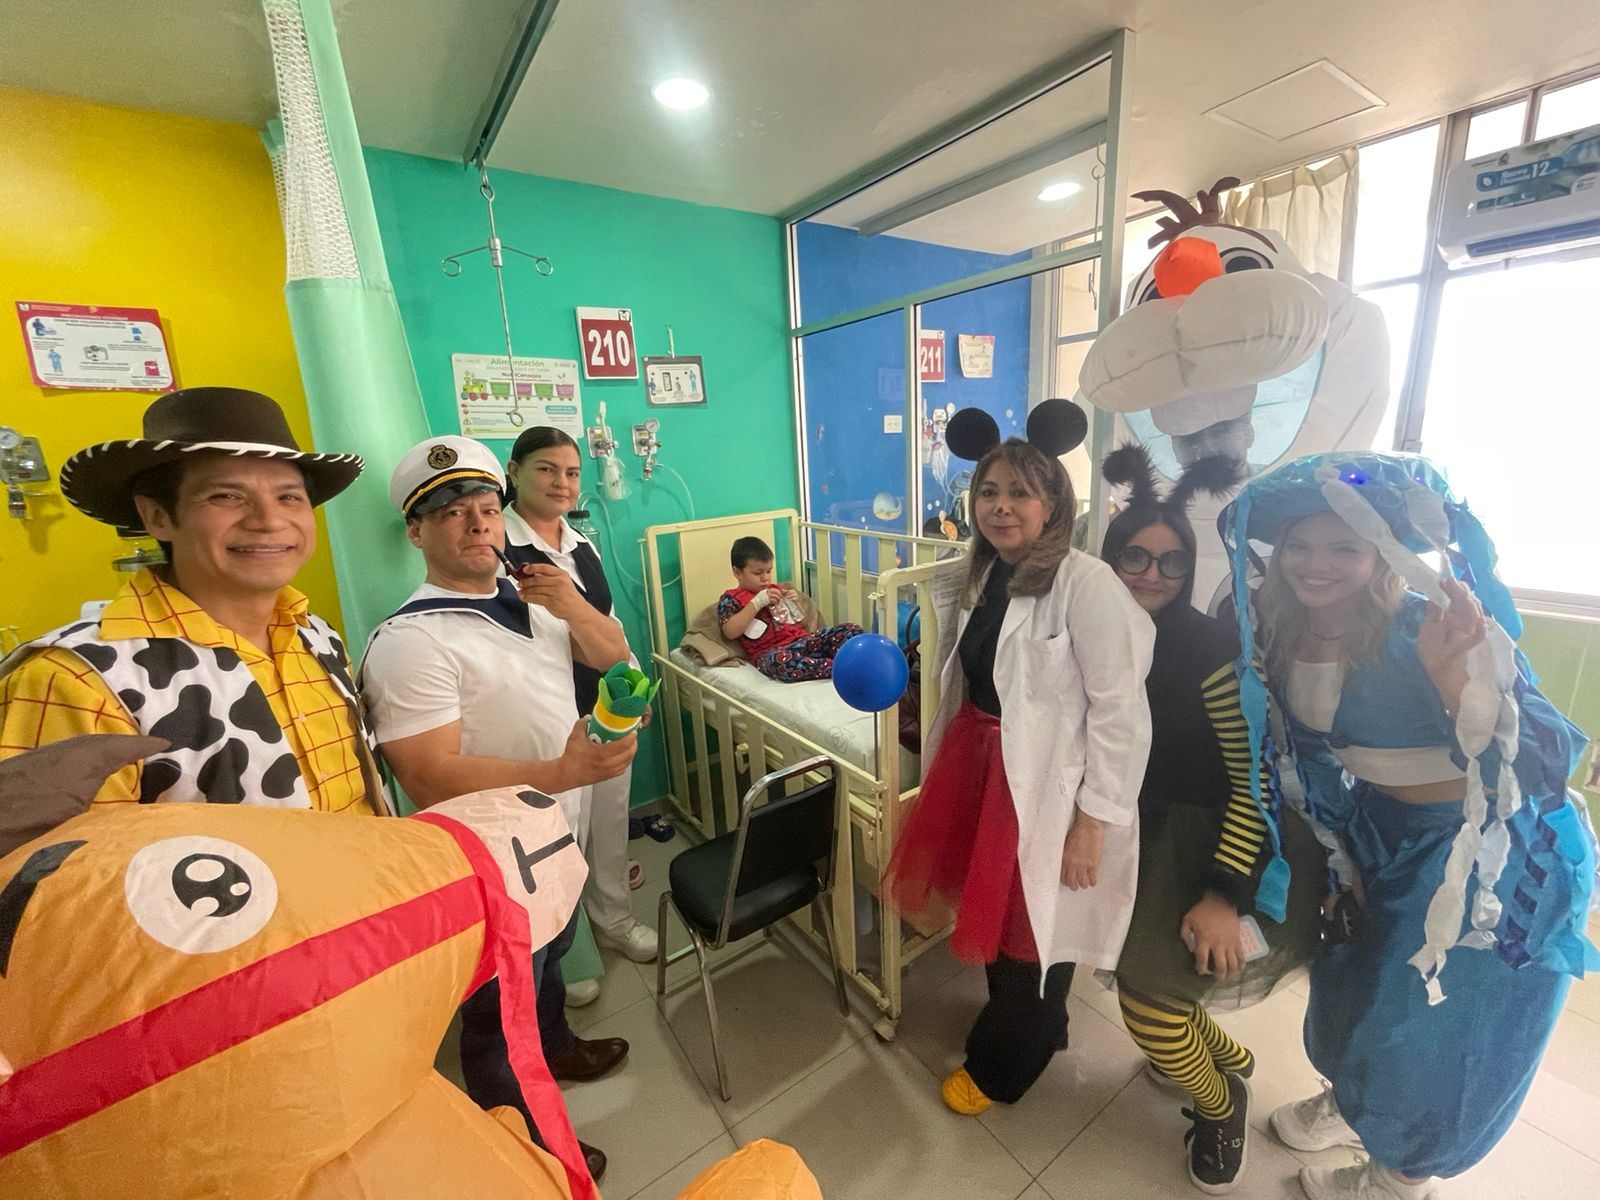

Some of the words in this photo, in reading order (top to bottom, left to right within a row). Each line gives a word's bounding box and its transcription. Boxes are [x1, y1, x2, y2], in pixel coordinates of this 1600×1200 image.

[1532, 161, 1550, 178] 12
[588, 329, 630, 367] 210
[920, 345, 942, 373] 211
[490, 358, 545, 367] Alimntación
